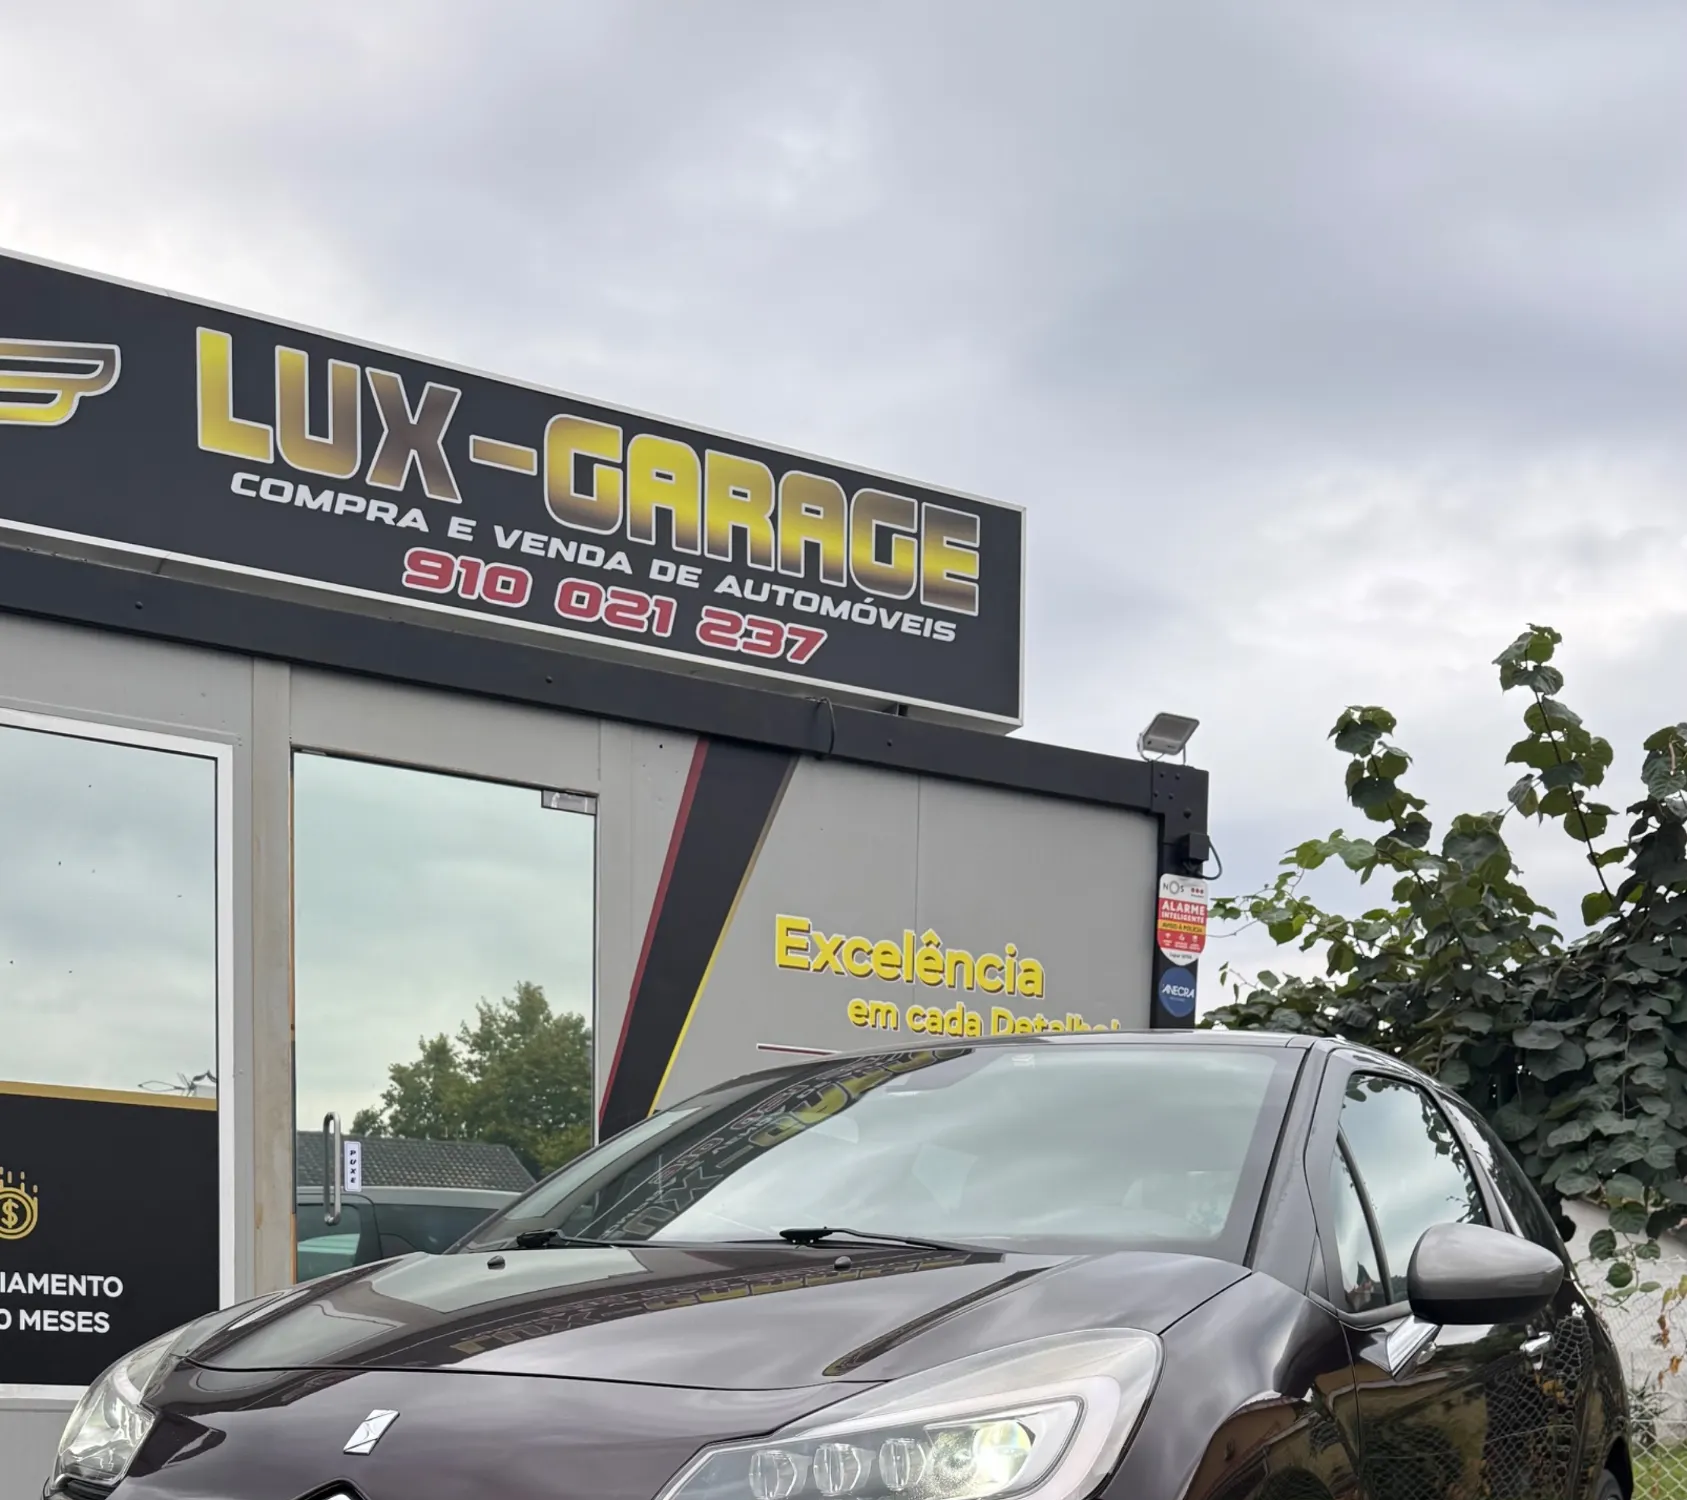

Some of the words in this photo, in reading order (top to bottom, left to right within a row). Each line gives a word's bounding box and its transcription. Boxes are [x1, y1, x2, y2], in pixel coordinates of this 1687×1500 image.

[196, 326, 980, 616] LUX-GARAGE
[231, 472, 429, 532] COMPRA
[447, 516, 477, 541] E
[494, 525, 633, 575] VENDA
[649, 558, 702, 589] DE
[714, 574, 957, 643] AUTOMÓVEIS
[402, 547, 533, 608] 910
[555, 577, 677, 637] 021
[695, 607, 828, 665] 237
[1163, 880, 1184, 895] NOS
[1161, 911, 1205, 924] INTELIGENTE
[1162, 900, 1206, 916] ALARME
[775, 912, 1046, 999] Excelência
[848, 998, 899, 1031] em
[905, 1001, 983, 1037] cada
[19, 1309, 110, 1334] MESES
